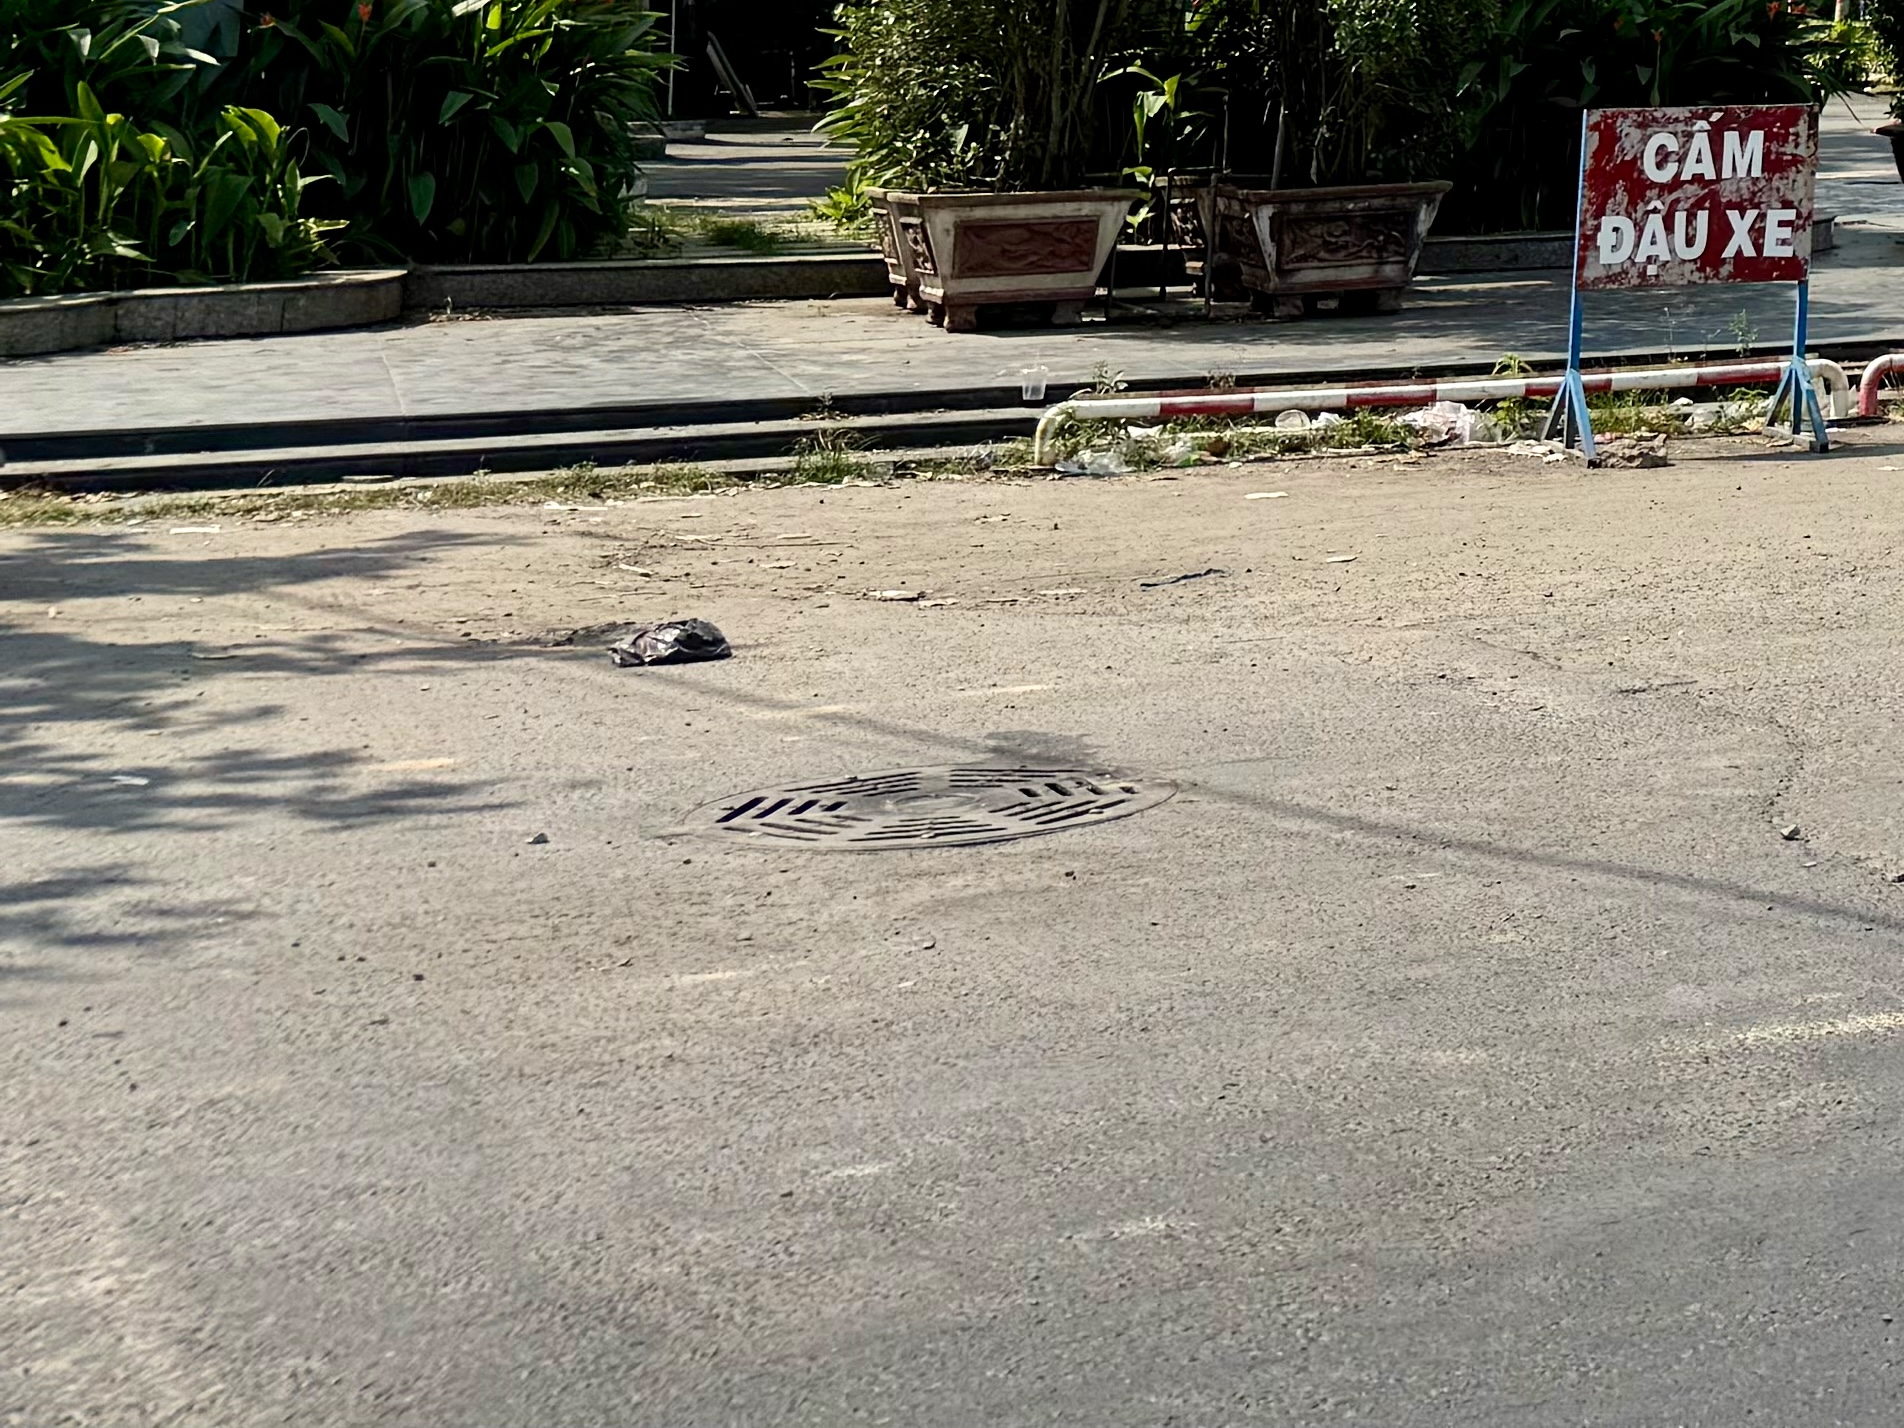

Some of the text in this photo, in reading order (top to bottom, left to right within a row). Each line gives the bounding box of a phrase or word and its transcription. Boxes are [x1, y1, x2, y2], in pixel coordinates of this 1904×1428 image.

[1643, 112, 1764, 183] CẤM
[1597, 200, 1796, 275] ĐẬU XE
